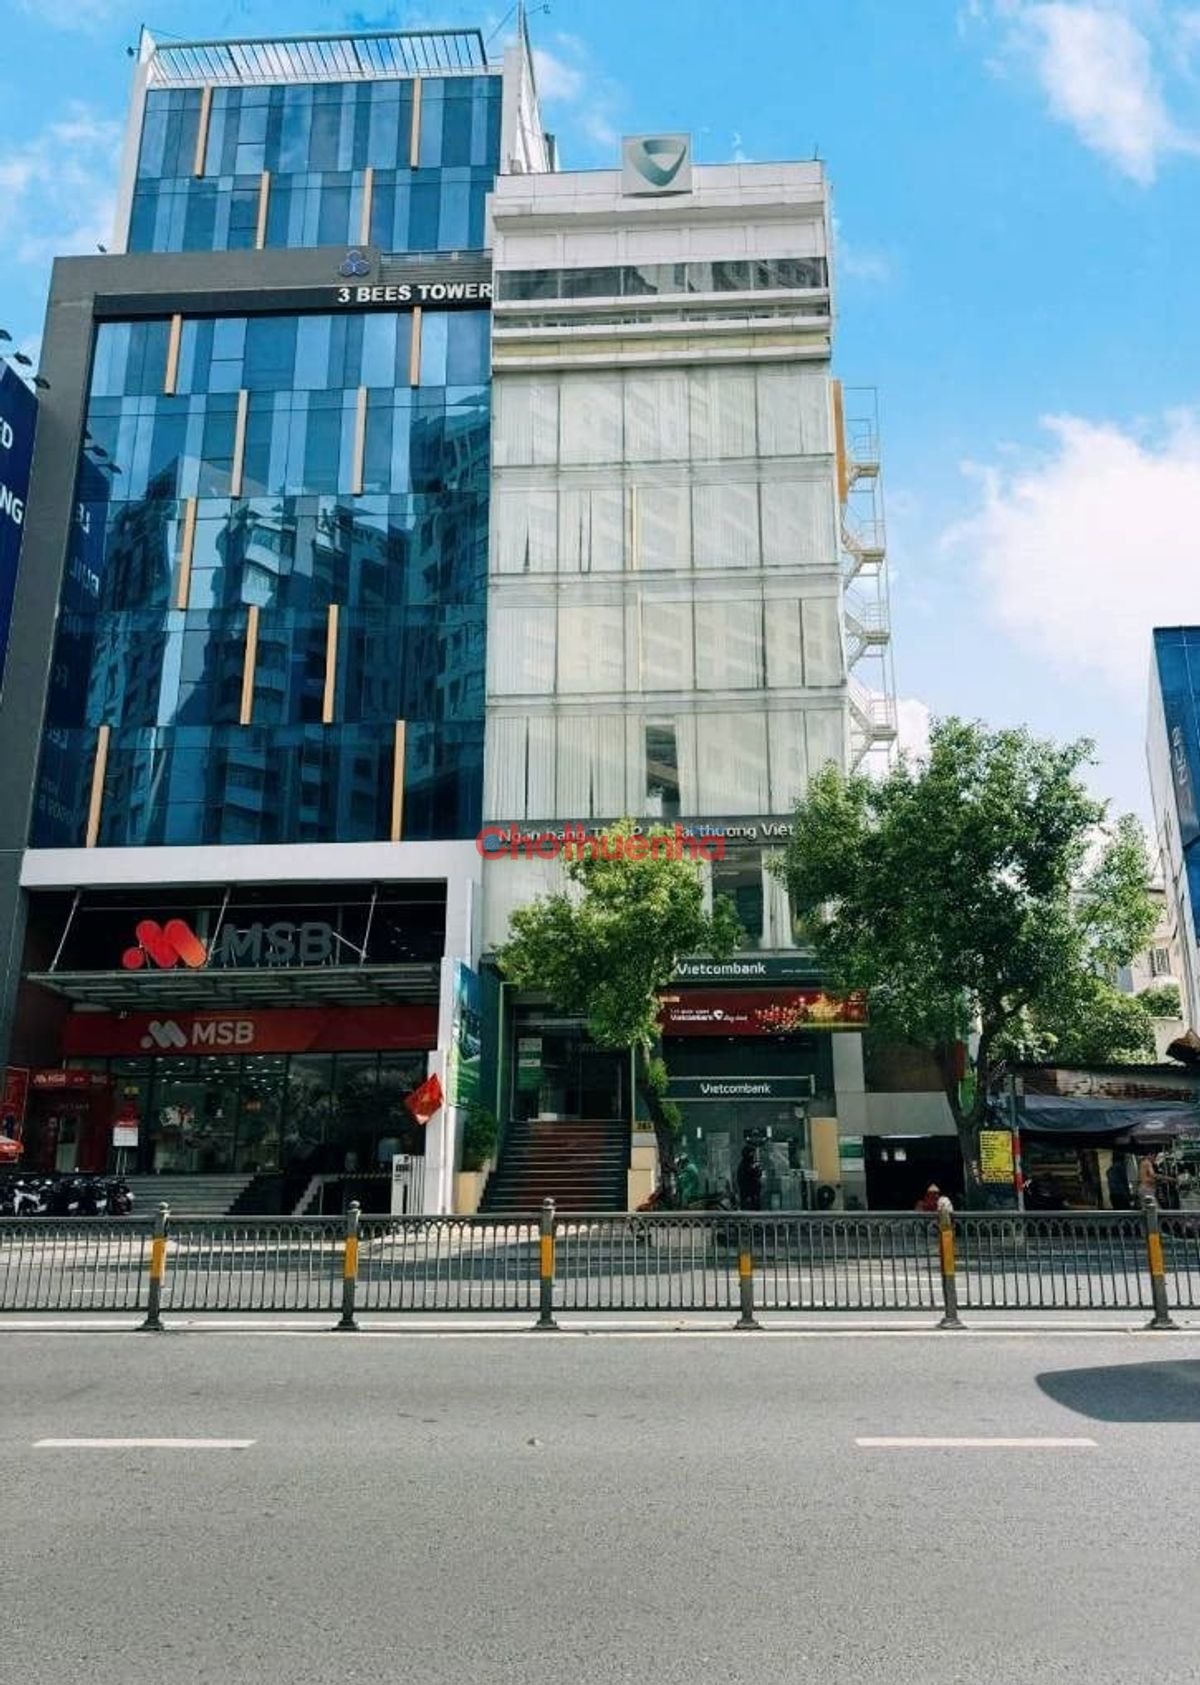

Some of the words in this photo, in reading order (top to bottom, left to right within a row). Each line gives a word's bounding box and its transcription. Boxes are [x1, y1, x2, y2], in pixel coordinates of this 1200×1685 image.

[338, 287, 350, 302] 3
[356, 285, 411, 302] BEES
[418, 282, 492, 299] TOWER
[221, 922, 332, 962] MSB
[677, 961, 767, 975] Vietcombank
[192, 1021, 254, 1045] MSB
[700, 1083, 771, 1094] Vietcombank
